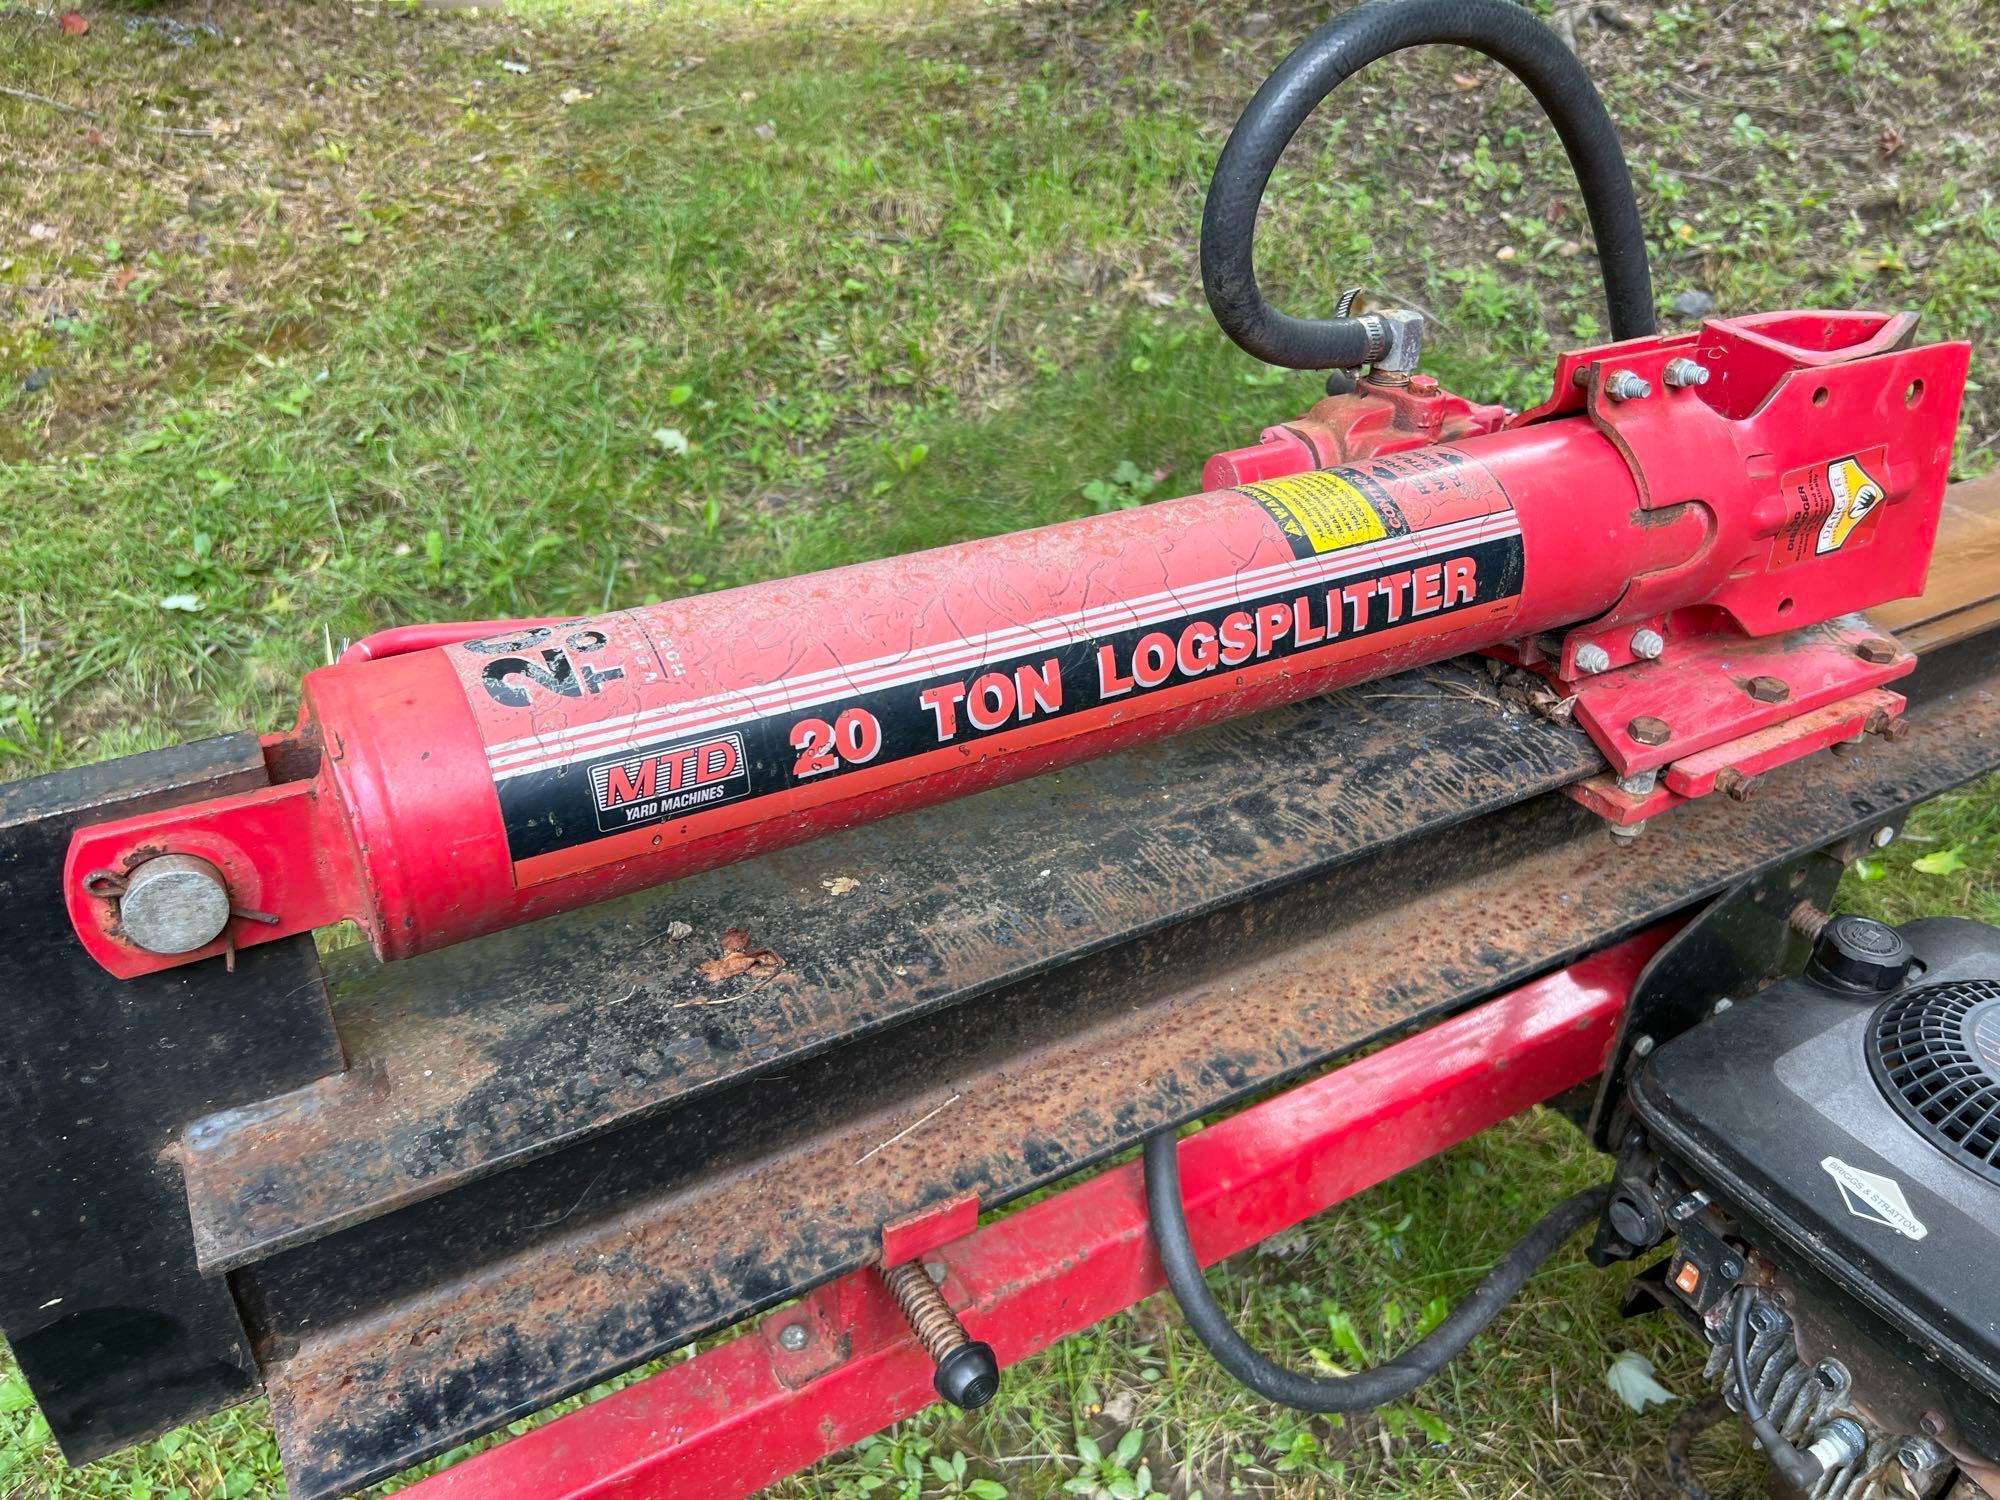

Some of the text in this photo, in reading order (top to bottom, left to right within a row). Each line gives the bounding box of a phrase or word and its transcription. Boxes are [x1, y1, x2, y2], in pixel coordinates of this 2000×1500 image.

[1822, 477, 1847, 540] DANGER
[790, 557, 1478, 779] 20 TON LOGSPLITTER
[607, 741, 737, 806] MTD
[625, 785, 725, 822] YARD MACHINES
[1828, 1161, 1920, 1234] BRIGGS & STRATTON
